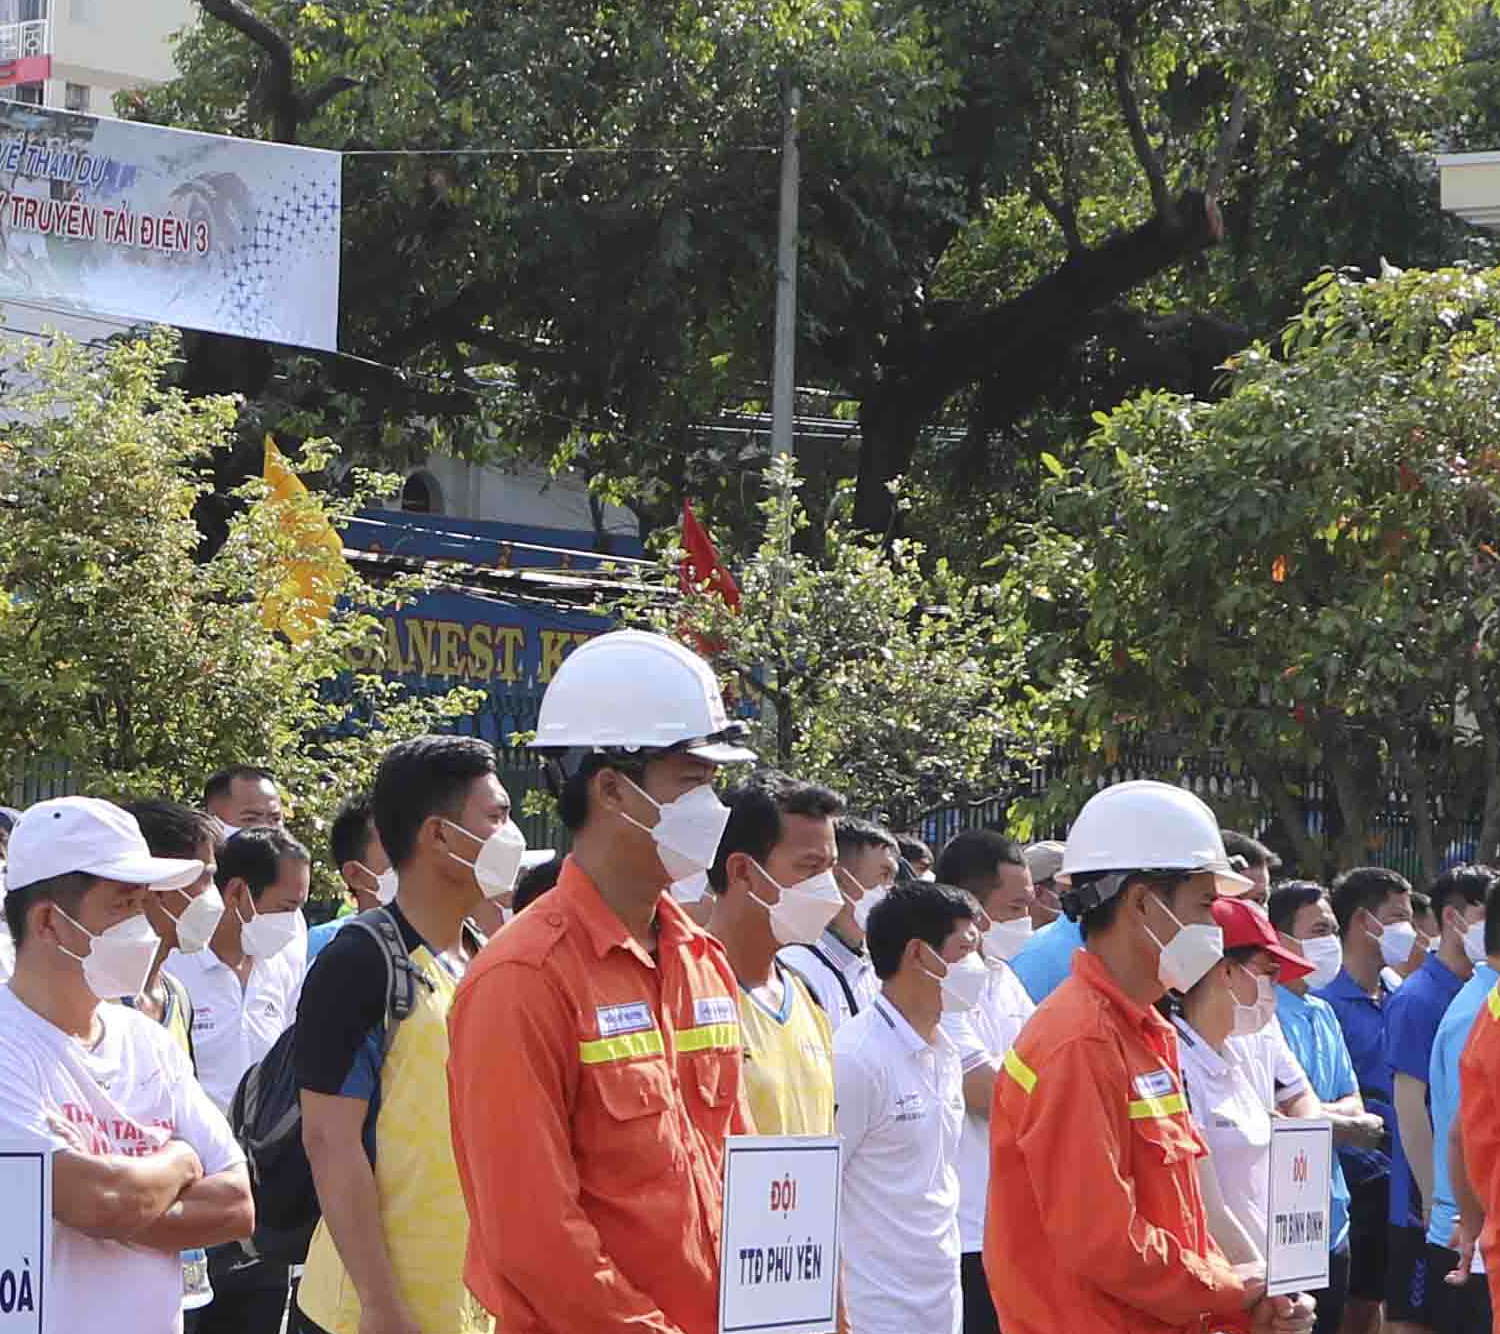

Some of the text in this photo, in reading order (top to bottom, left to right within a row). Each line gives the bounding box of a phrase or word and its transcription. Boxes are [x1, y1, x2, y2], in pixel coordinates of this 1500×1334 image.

[12, 192, 95, 238] TRUYỀN
[103, 200, 134, 243] TẢI
[140, 212, 190, 257] ĐIỆN
[196, 219, 209, 253] 3
[770, 1172, 797, 1219] ĐỘI
[739, 1234, 822, 1285] TTĐ PHÚ YÊN
